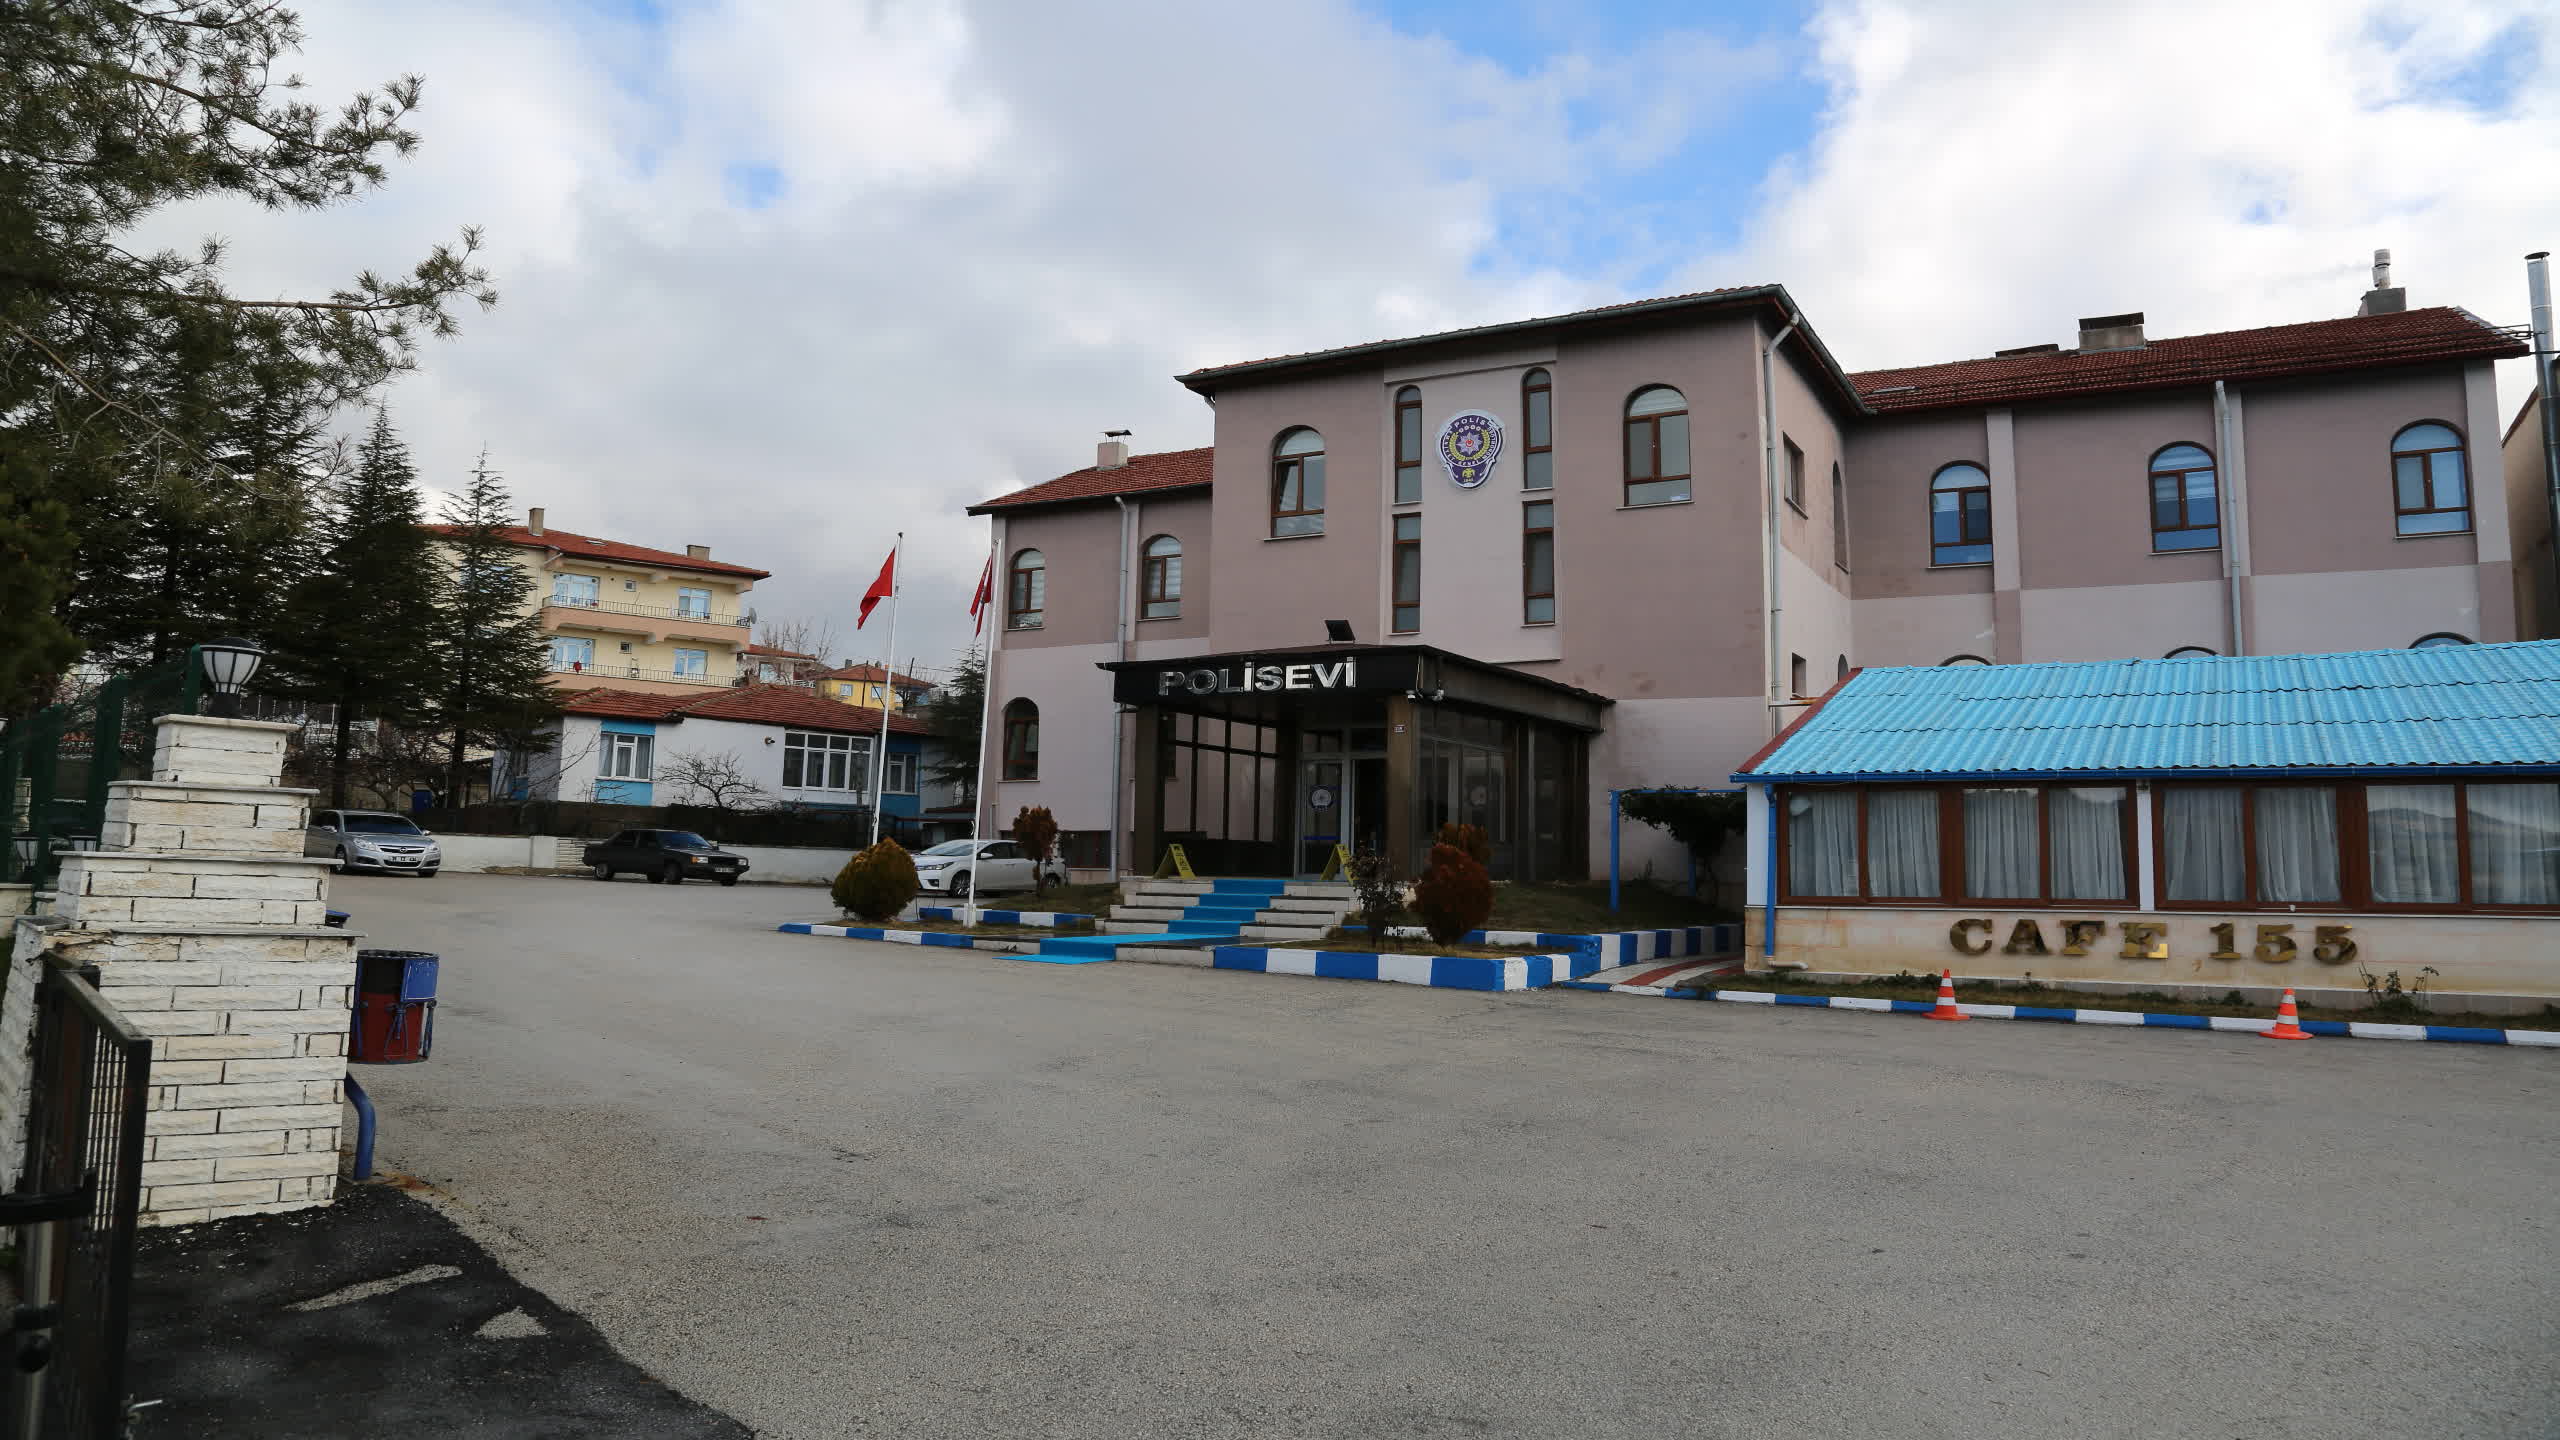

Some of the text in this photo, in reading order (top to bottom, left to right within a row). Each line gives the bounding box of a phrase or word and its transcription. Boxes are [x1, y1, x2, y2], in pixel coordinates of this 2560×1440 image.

[1454, 417, 1486, 427] POLİS
[1158, 656, 1357, 696] POLİSEVİ
[1949, 918, 2359, 964] CAFE 155
